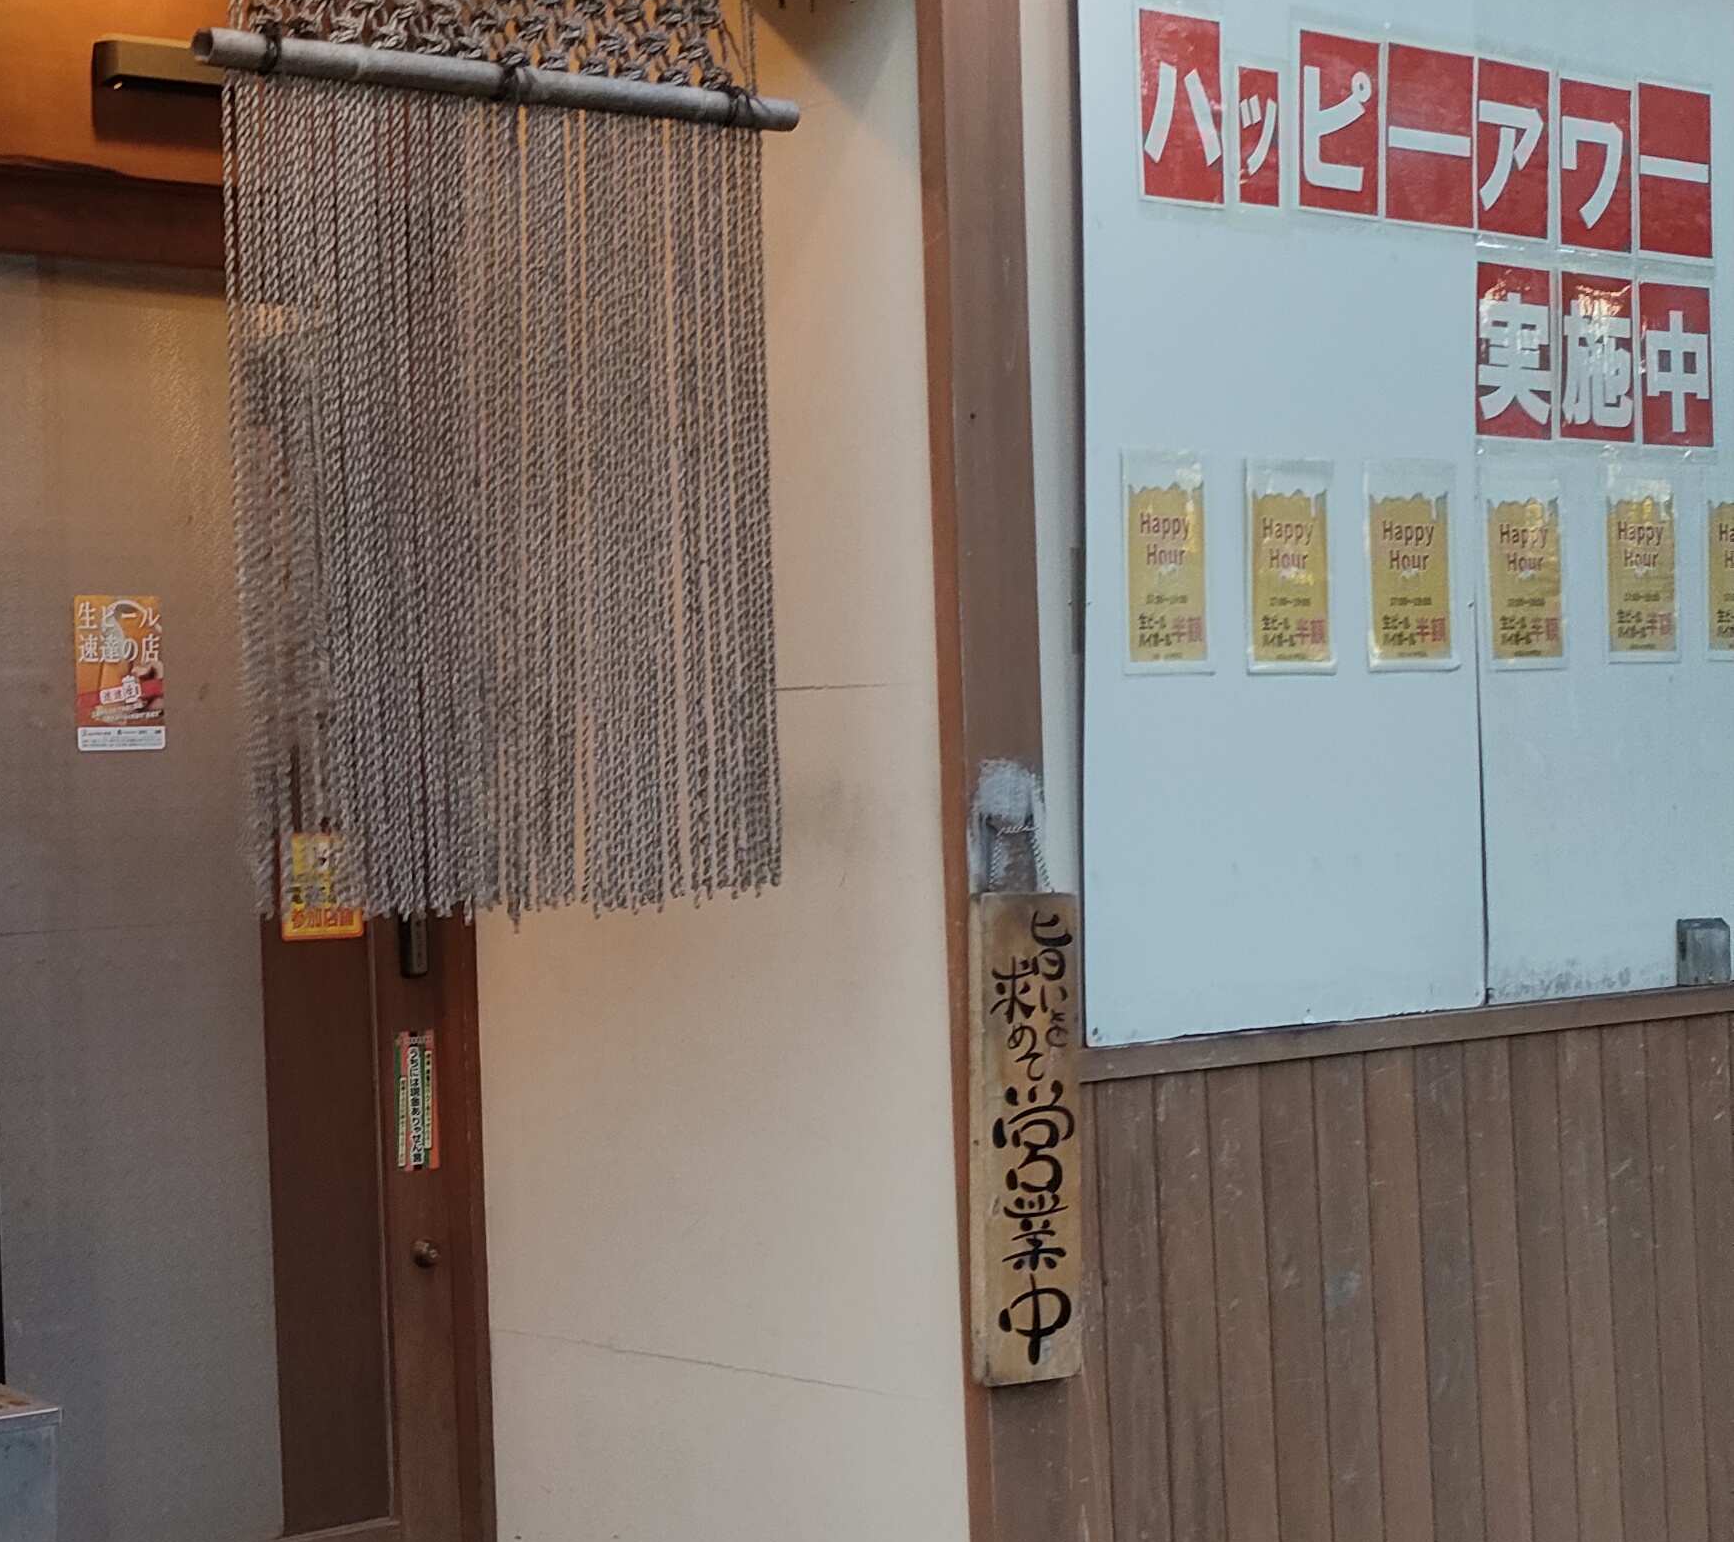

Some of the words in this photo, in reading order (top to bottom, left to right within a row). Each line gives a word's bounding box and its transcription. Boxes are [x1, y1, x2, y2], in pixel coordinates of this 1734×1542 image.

[1143, 61, 1710, 230] ハッピーアワー
[1477, 293, 1712, 433] 実施中
[1139, 512, 1189, 540] Happy
[1262, 516, 1313, 546] Happy
[1383, 519, 1434, 547] Happy
[1499, 523, 1548, 549] Happy
[1617, 521, 1664, 546] Happy
[1146, 544, 1185, 565] Hour
[1269, 549, 1309, 569] Hour
[1389, 550, 1429, 570] Hour
[1507, 552, 1544, 571] Hour
[1624, 549, 1659, 568] Hour
[78, 601, 160, 629] 生ビール
[78, 633, 160, 663] 速達の店
[990, 955, 1045, 1081] 求めて
[992, 1079, 1074, 1366] 営業中
